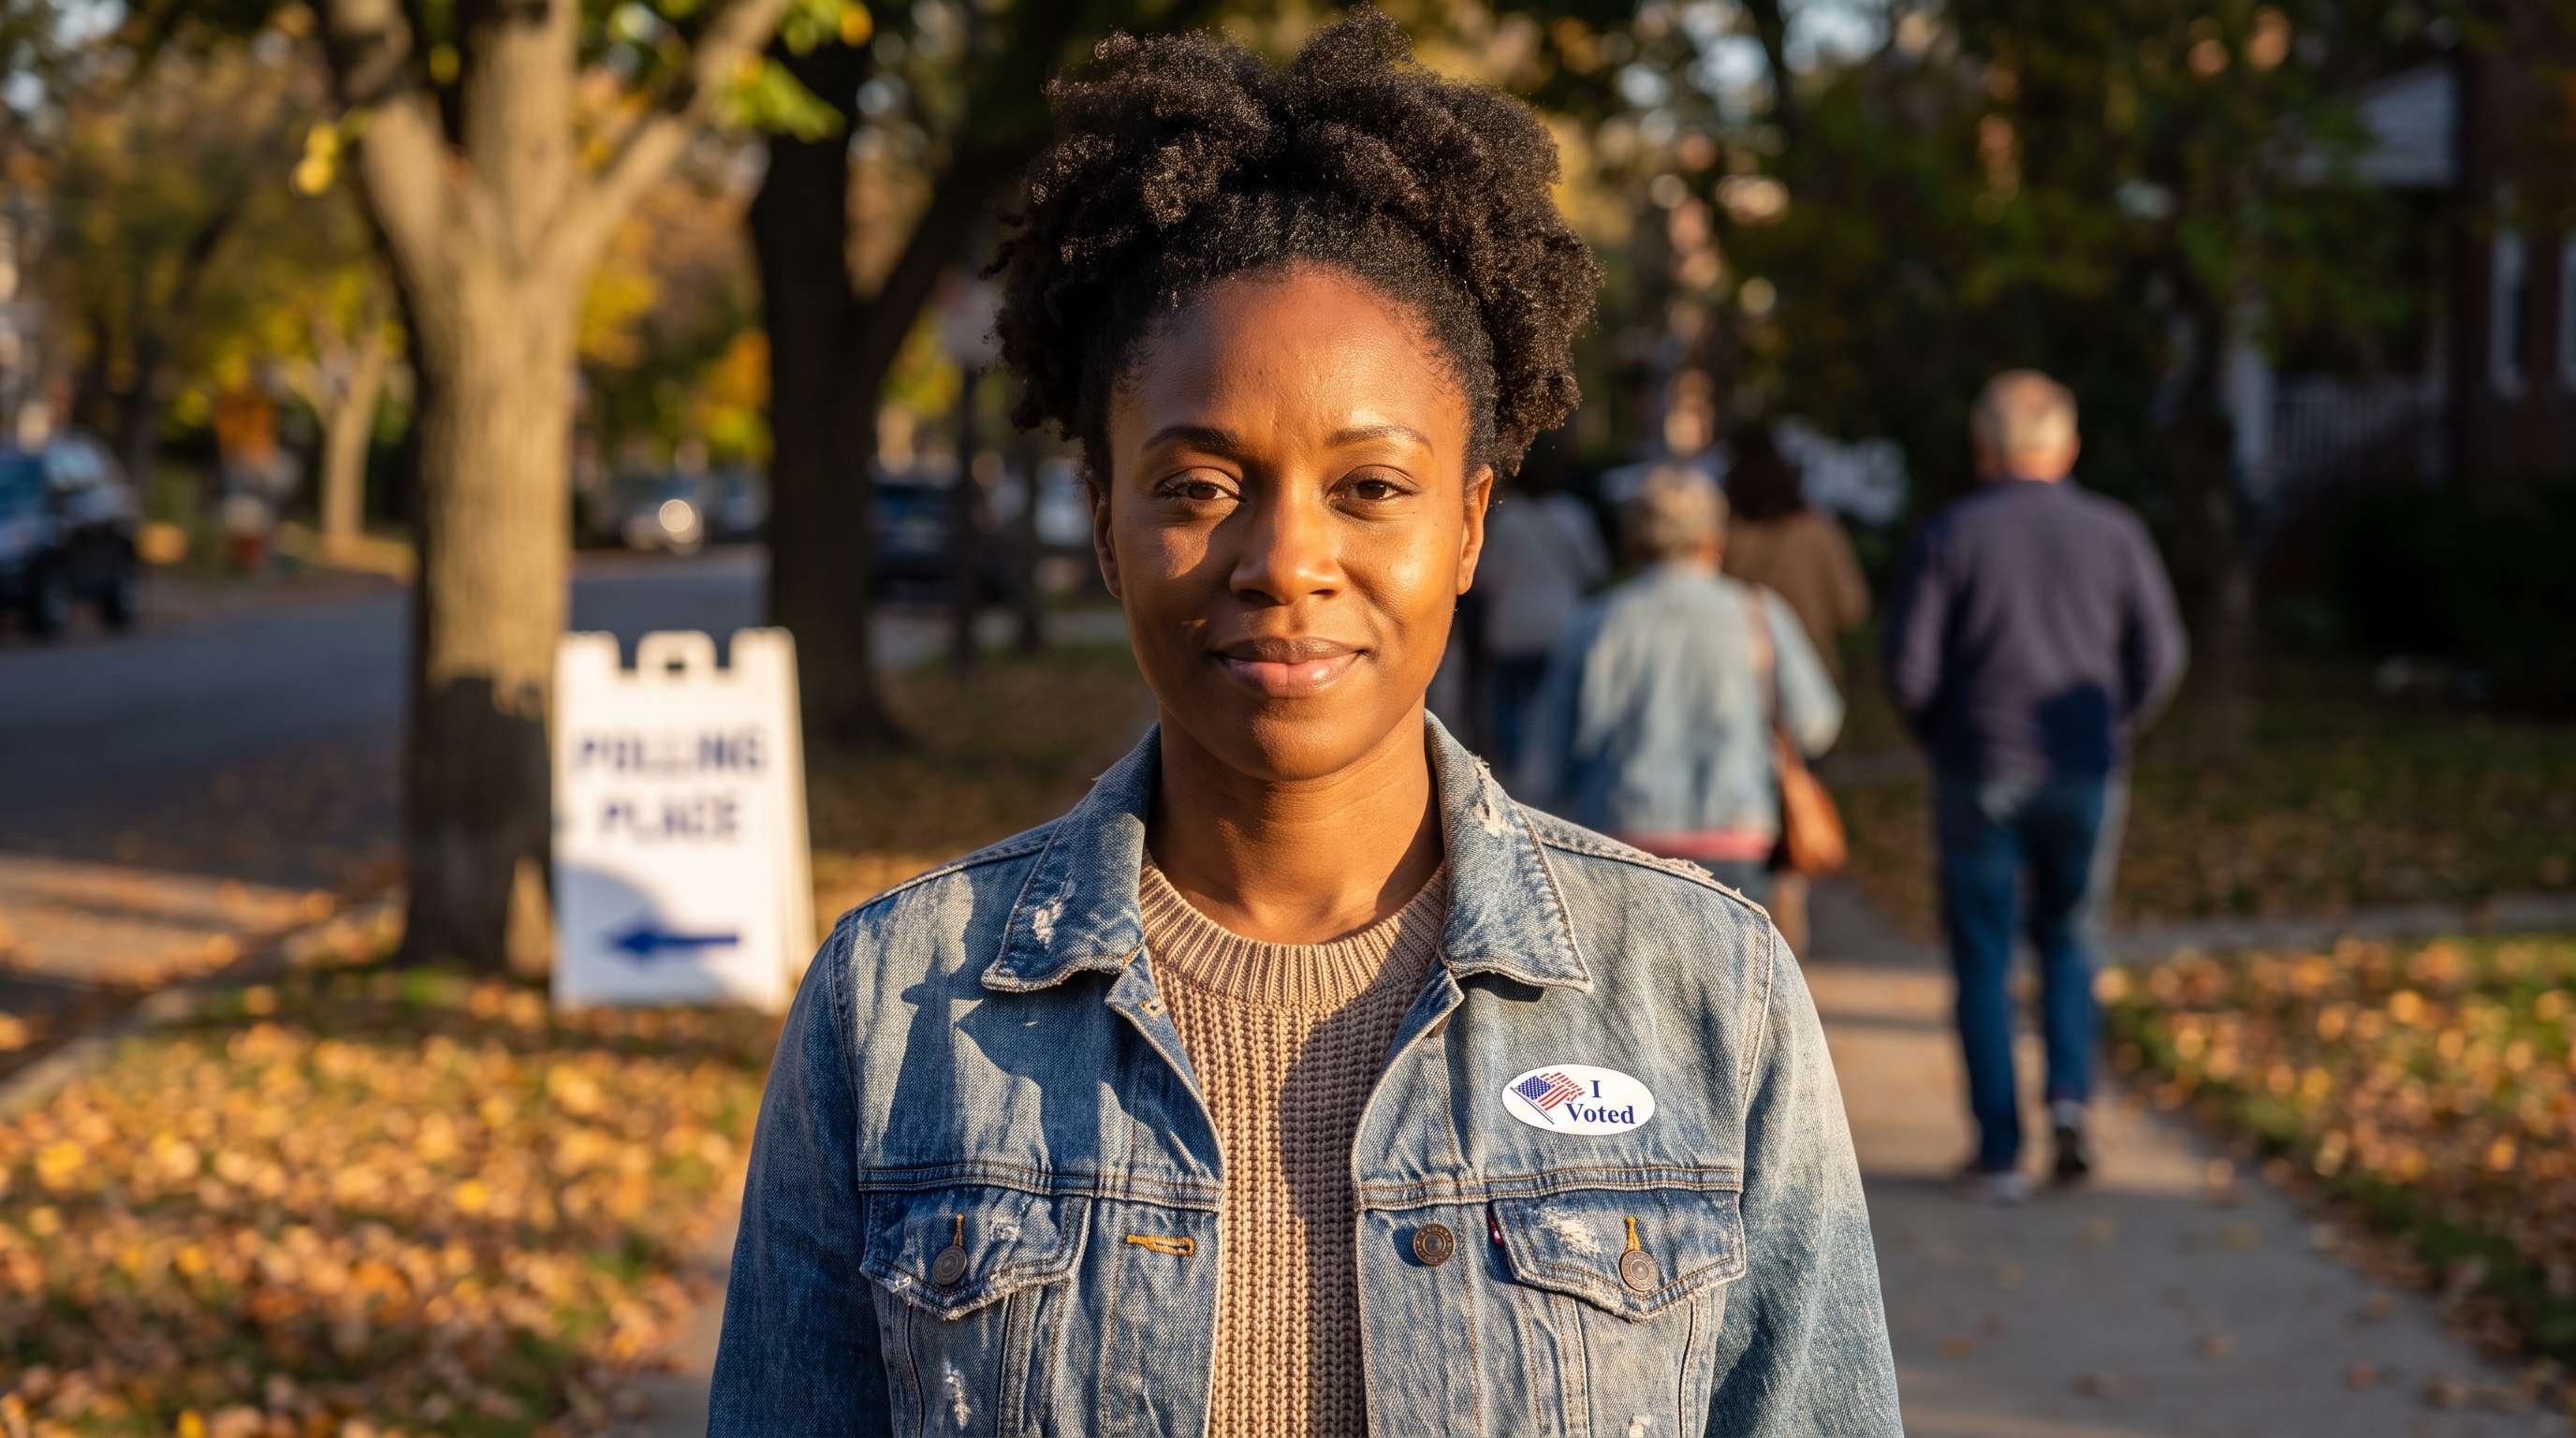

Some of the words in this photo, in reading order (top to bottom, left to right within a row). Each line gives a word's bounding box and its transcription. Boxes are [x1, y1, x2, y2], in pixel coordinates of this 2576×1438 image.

[601, 797, 738, 840] PLACE
[1590, 1079, 1603, 1099] I
[1564, 1103, 1635, 1125] Voted
